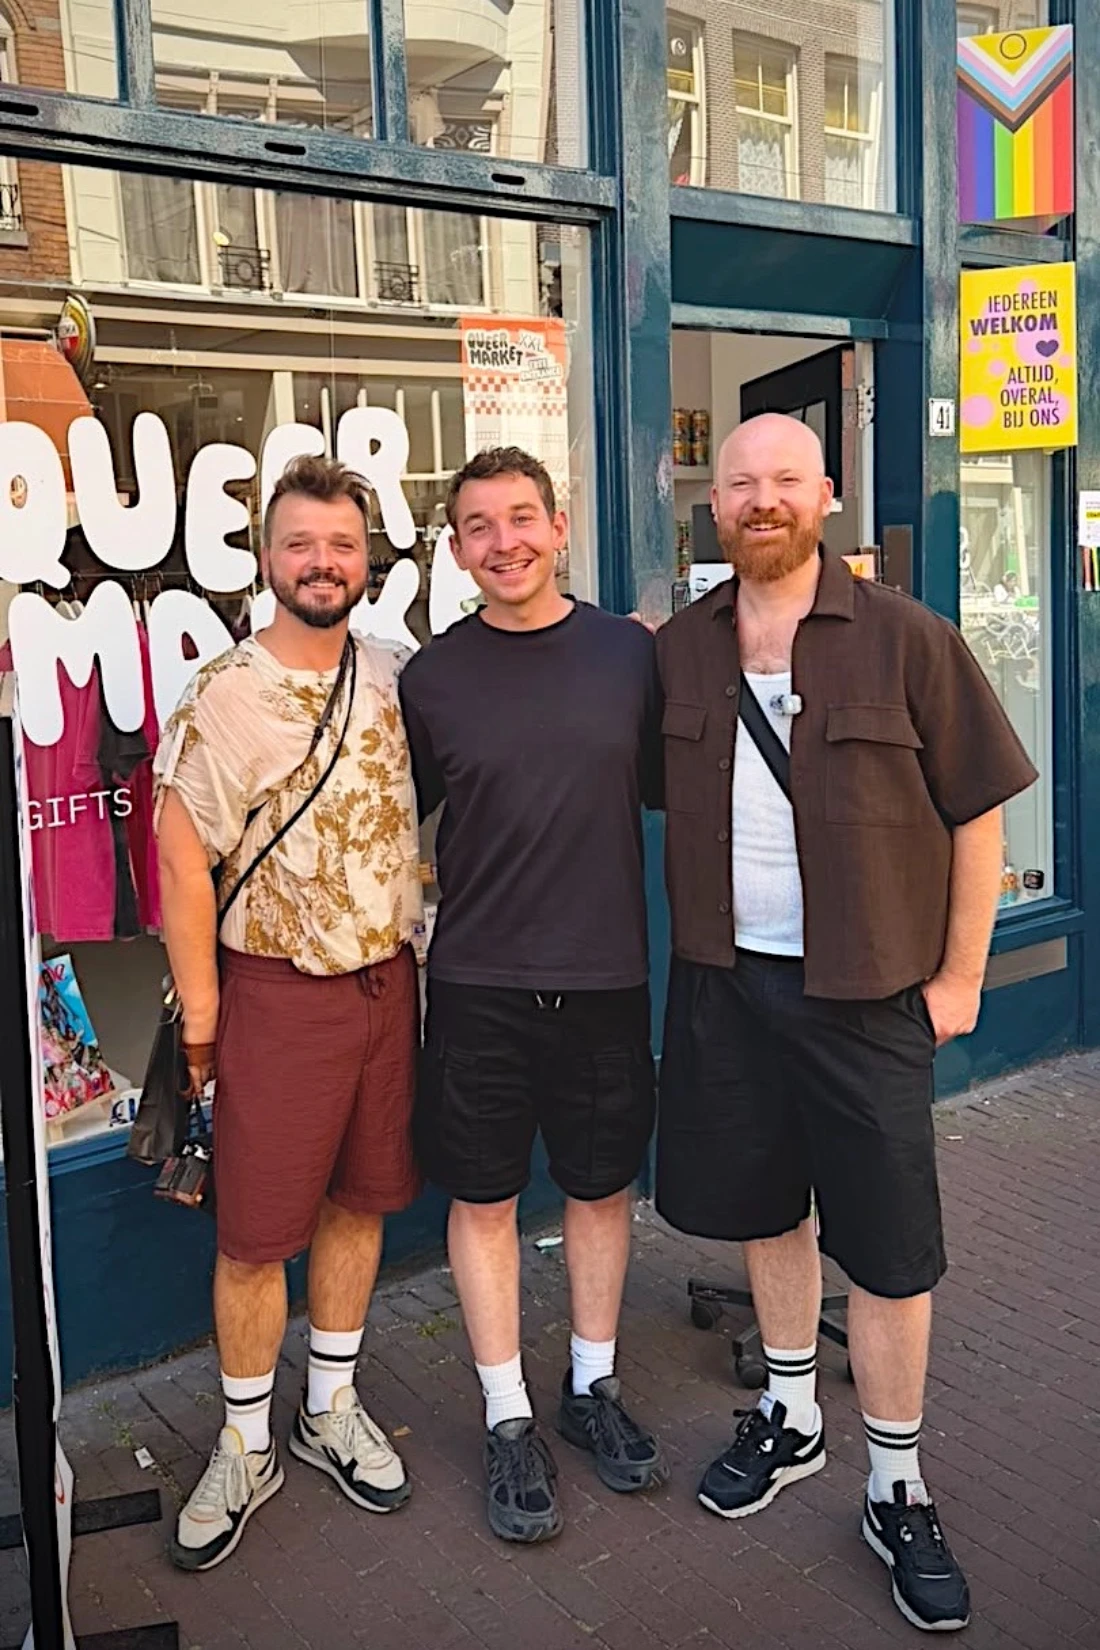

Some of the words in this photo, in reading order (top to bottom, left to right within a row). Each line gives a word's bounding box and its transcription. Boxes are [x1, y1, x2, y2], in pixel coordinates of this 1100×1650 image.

[988, 290, 1058, 313] IEDEREEN
[970, 313, 1058, 336] WELKOM
[468, 332, 509, 351] QUEER
[518, 333, 544, 353] XXL
[470, 346, 524, 367] MARKET
[1007, 364, 1059, 385] ALTIJD,
[1000, 387, 1060, 407] OVERAL,
[936, 405, 950, 430] 41
[1004, 410, 1024, 429] BIJ
[1030, 407, 1060, 426] ONS
[28, 788, 132, 830] GIFTS
